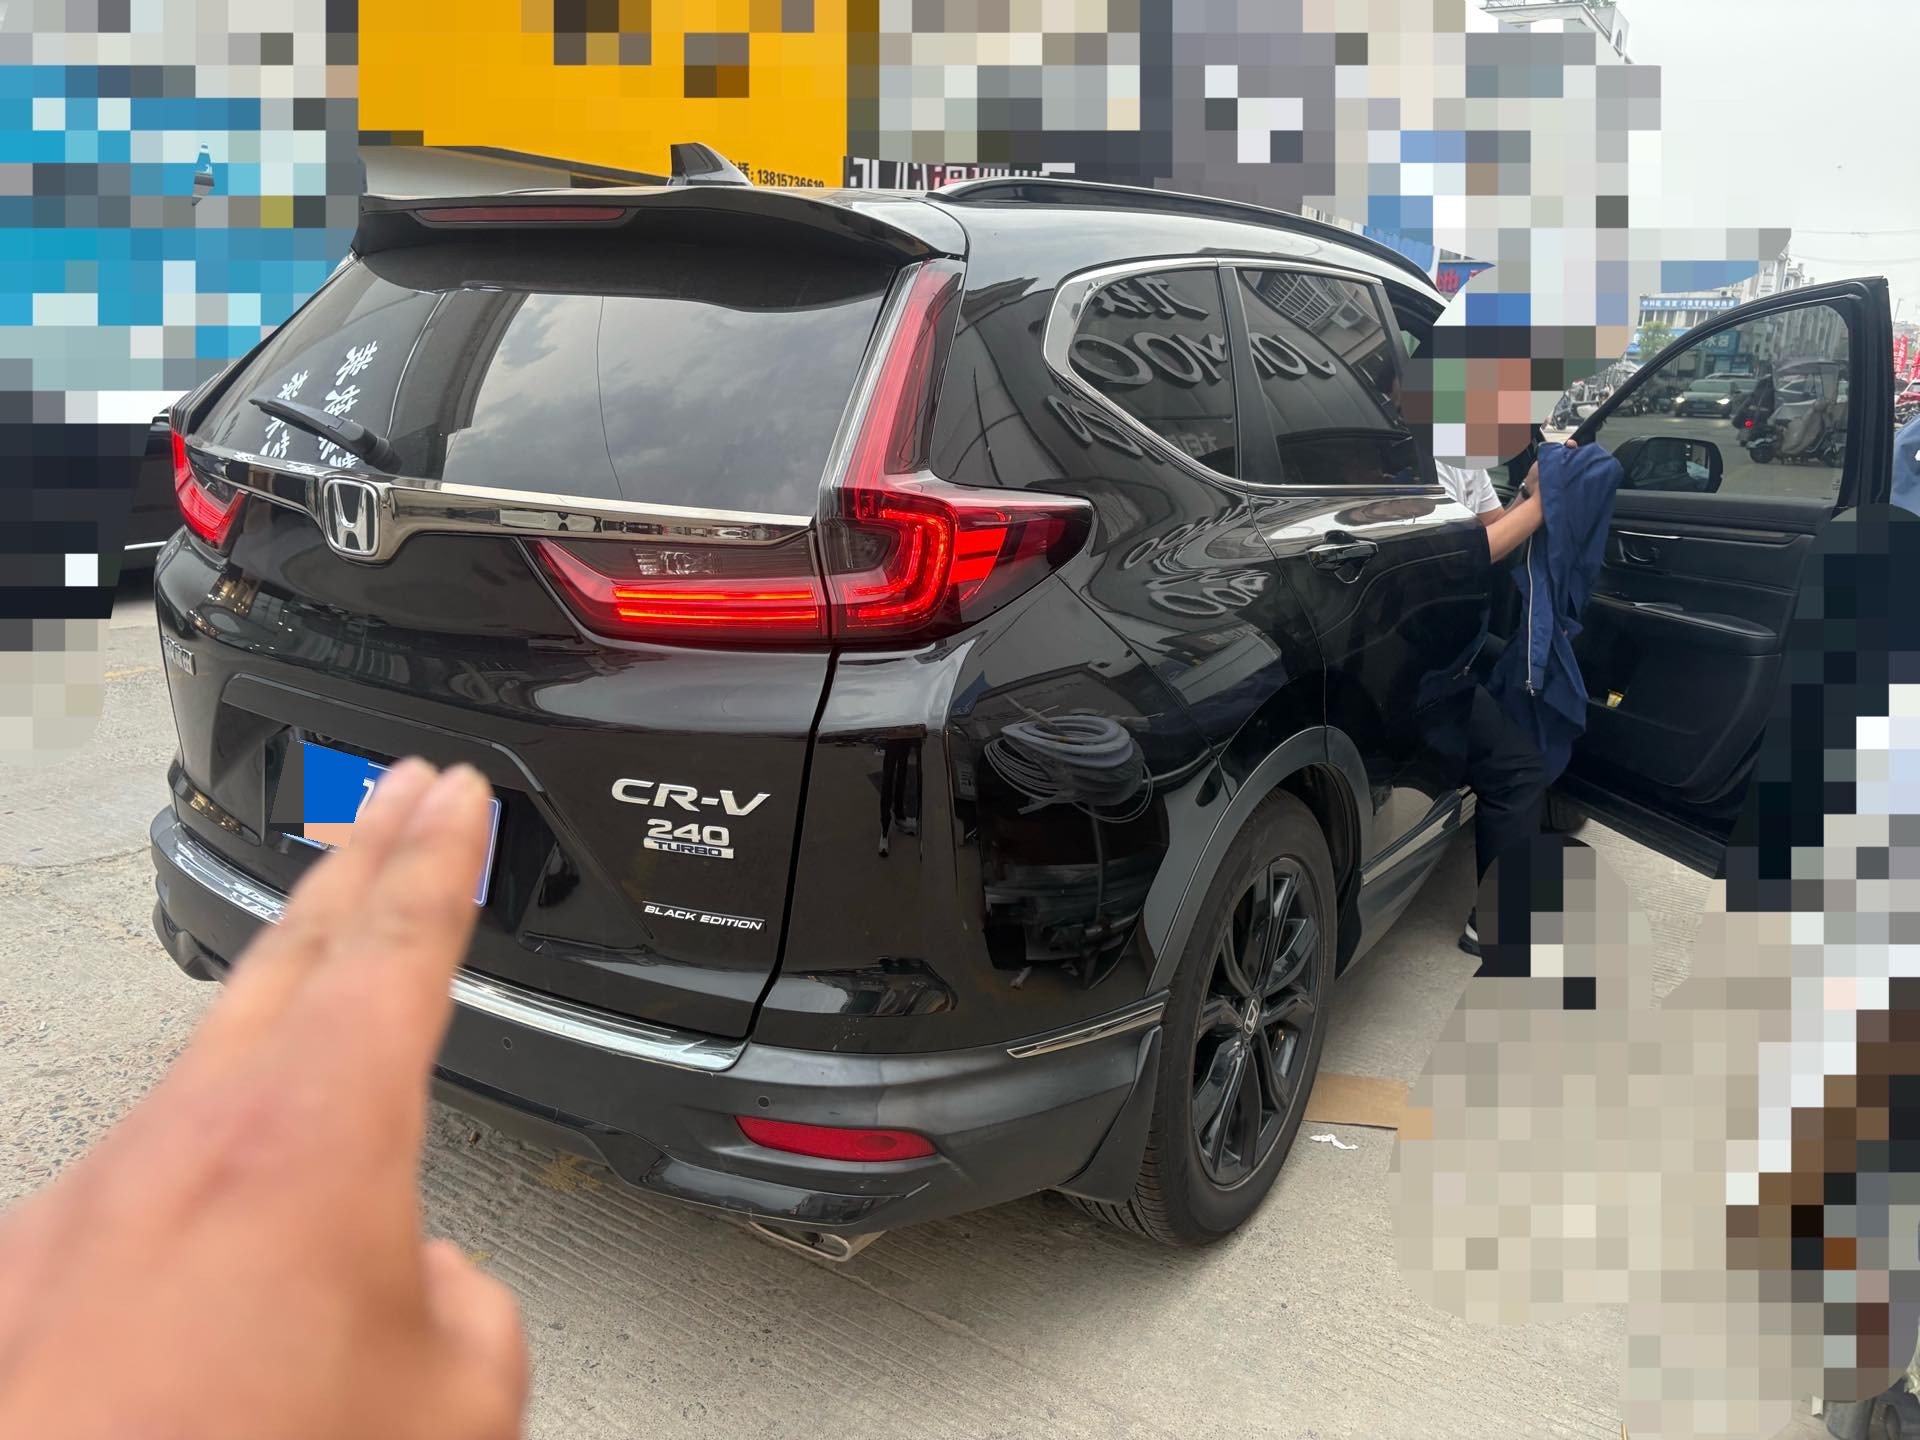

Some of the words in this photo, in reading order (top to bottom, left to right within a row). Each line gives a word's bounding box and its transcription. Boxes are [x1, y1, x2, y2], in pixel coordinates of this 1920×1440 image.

[611, 778, 771, 816] CR-V
[647, 818, 730, 847] 240
[654, 841, 722, 857] TURBO
[644, 905, 696, 921] BLACK
[699, 914, 763, 930] EDITION
